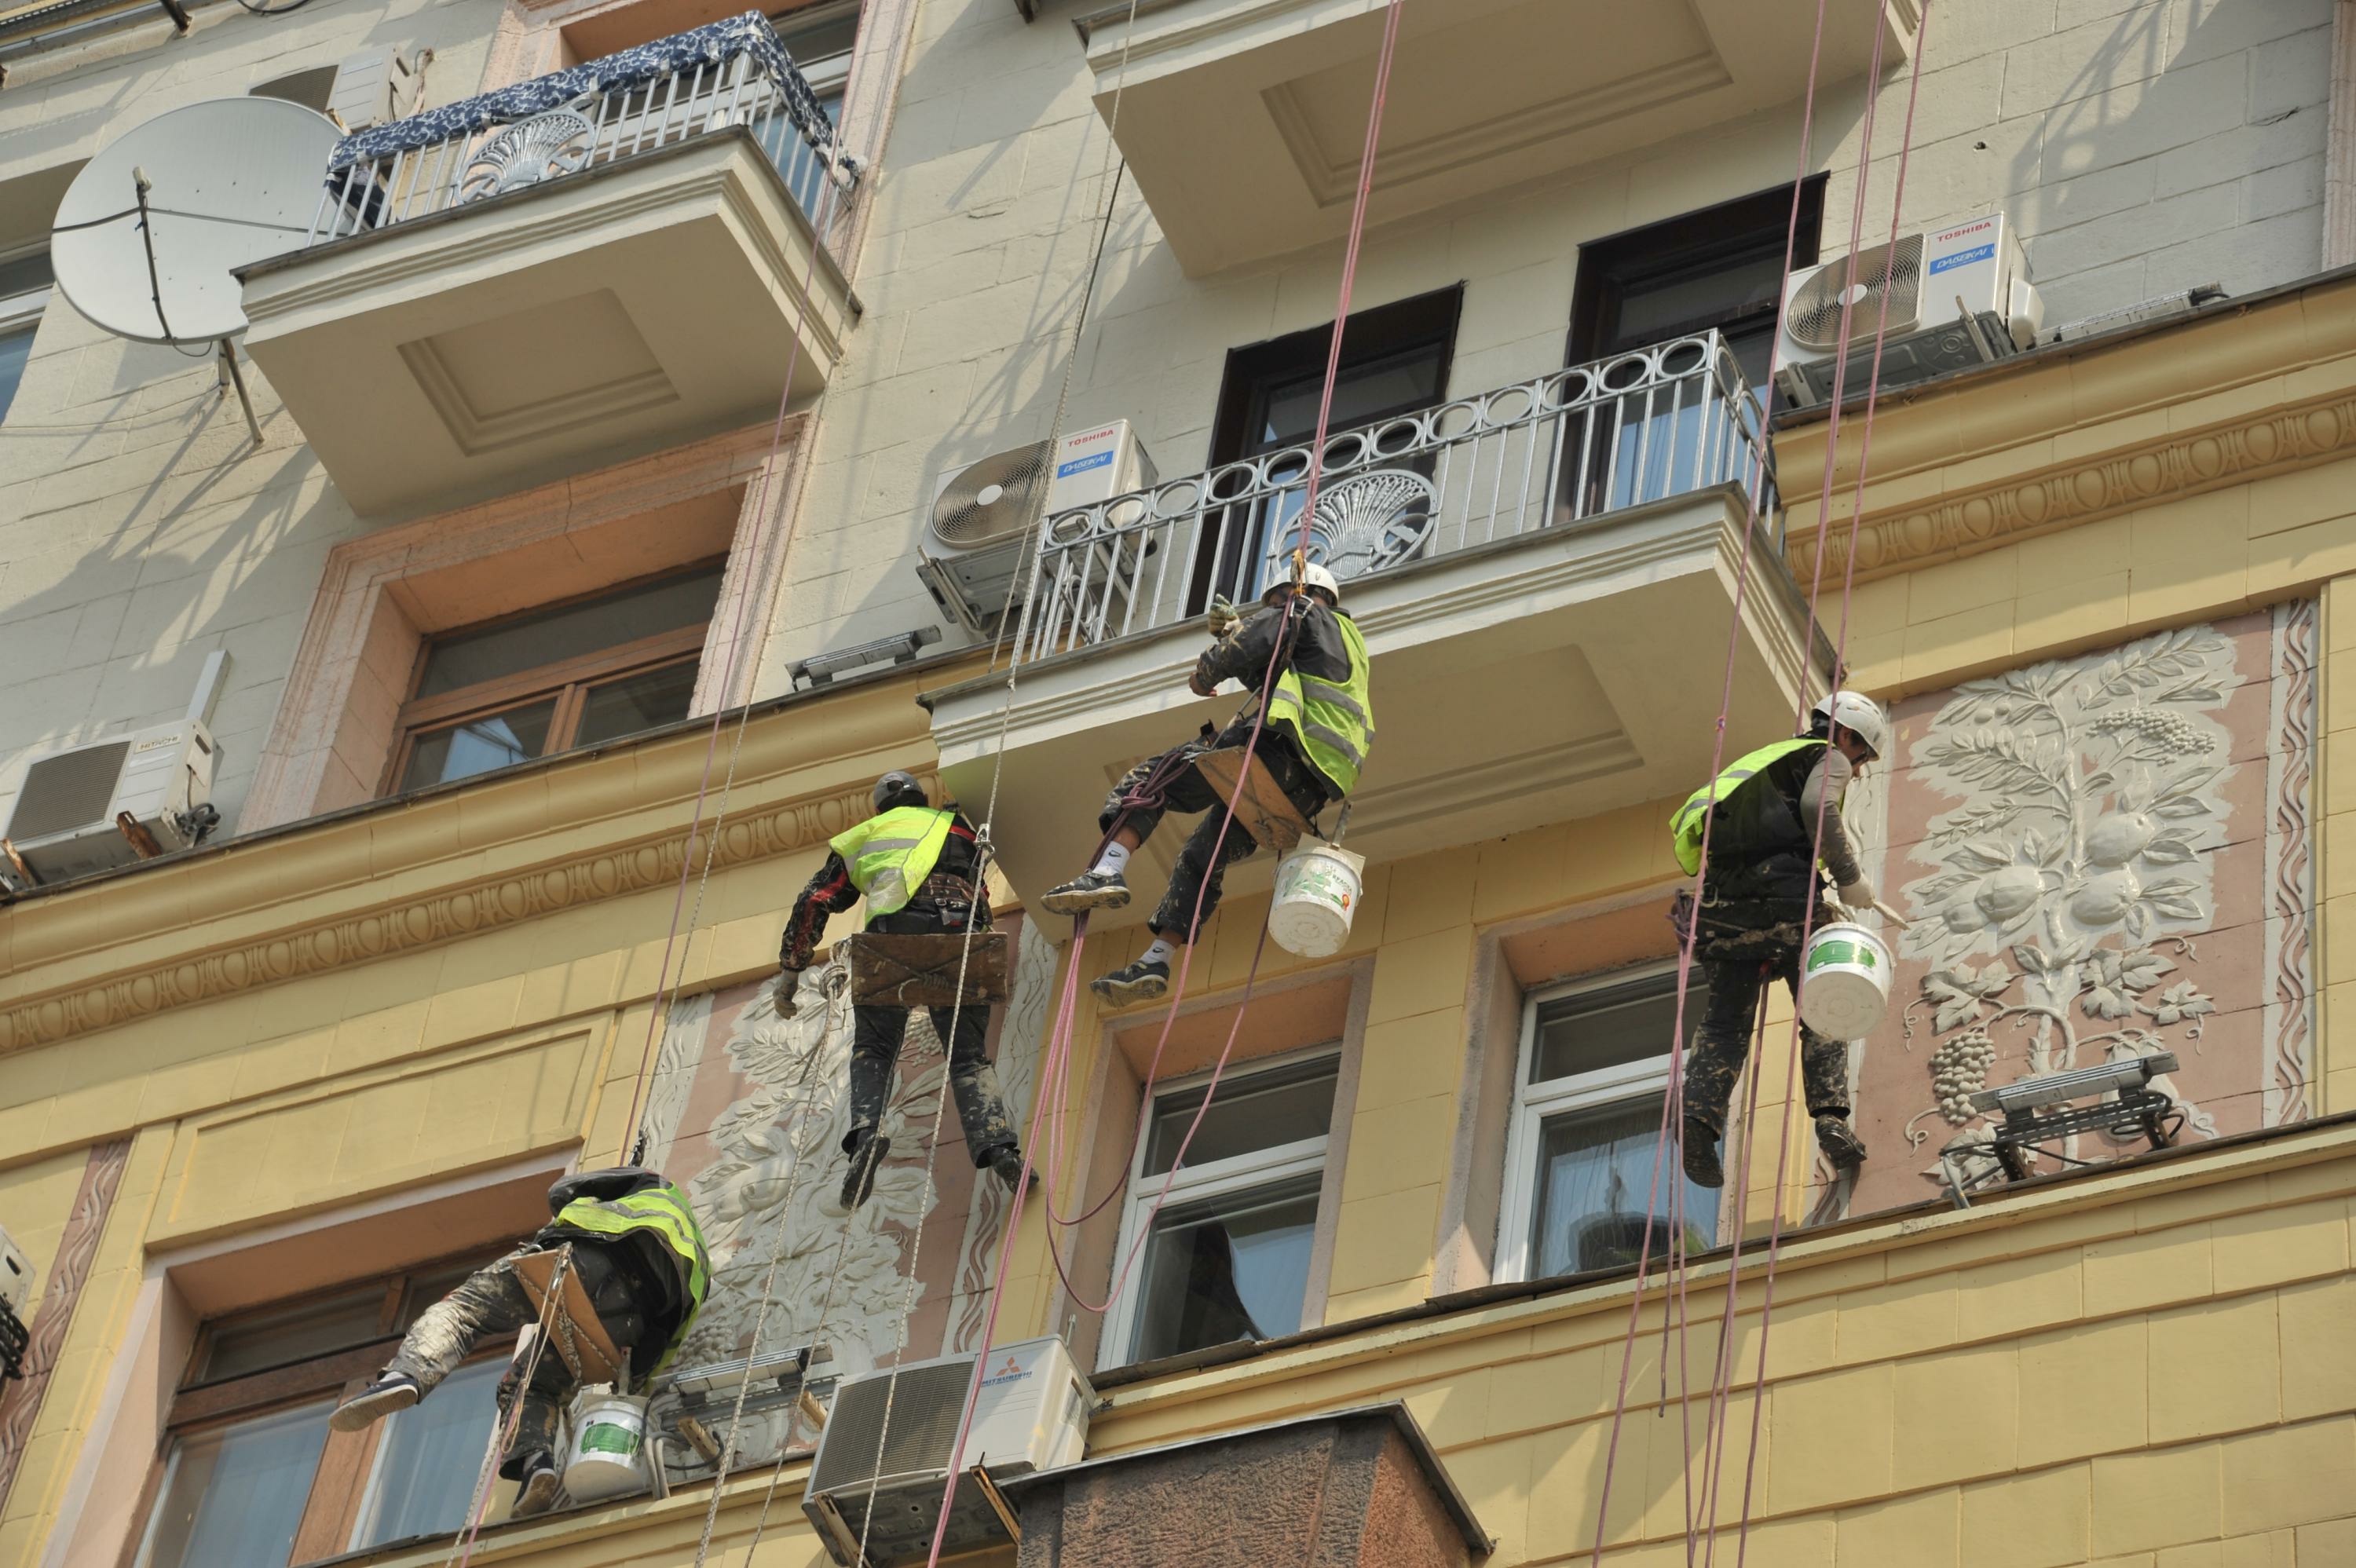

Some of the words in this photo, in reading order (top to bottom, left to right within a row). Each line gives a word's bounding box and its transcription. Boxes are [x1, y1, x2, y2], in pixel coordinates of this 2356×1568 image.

[1937, 221, 1992, 242] TOSHIBA
[1068, 429, 1114, 447] TOSHIBA
[981, 1371, 1033, 1385] MITSUBISHI
